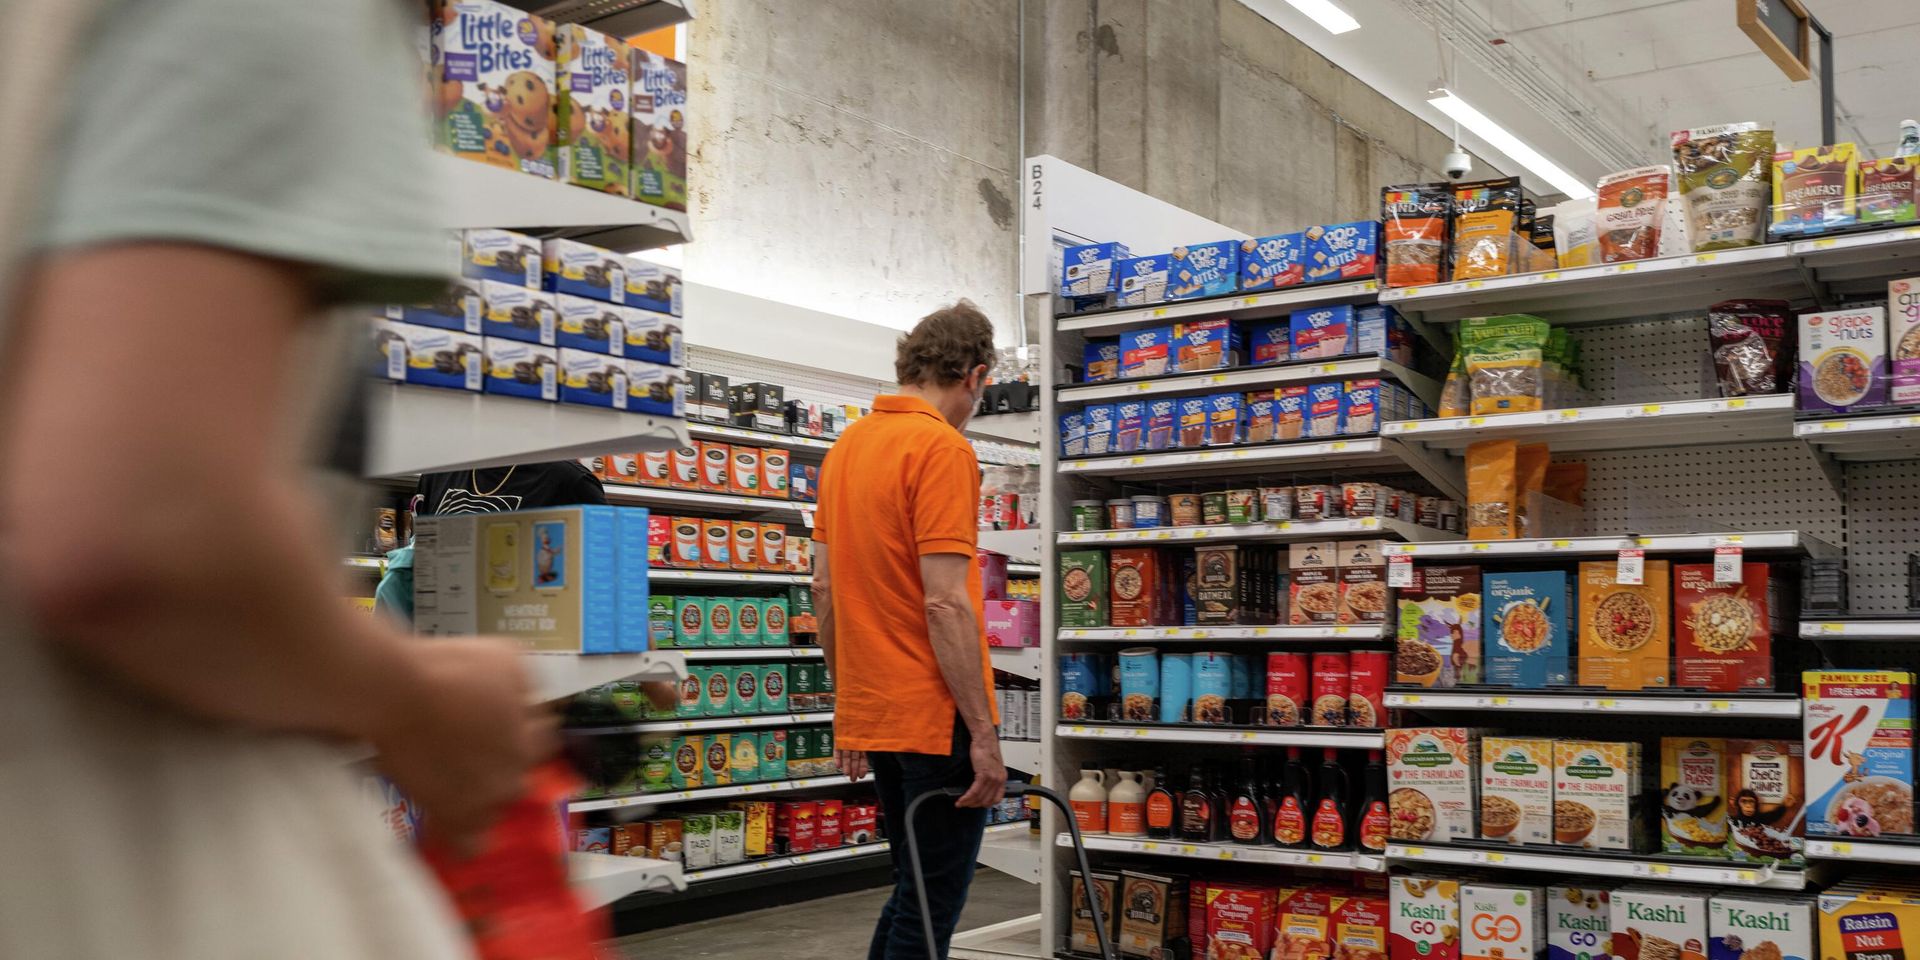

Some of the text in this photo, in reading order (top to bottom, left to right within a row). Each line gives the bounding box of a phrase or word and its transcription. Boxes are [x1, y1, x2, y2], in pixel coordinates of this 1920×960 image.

[461, 13, 513, 49] Little
[477, 43, 533, 73] Bites
[581, 46, 615, 71] Little
[592, 67, 627, 86] Bites
[644, 68, 677, 92] Little
[654, 89, 686, 106] Bites
[1032, 164, 1042, 210] B24
[1785, 185, 1842, 199] BREAKFAST
[1328, 248, 1358, 267] BITES
[1261, 259, 1290, 278] BITES
[1828, 314, 1874, 334] grape
[1587, 576, 1617, 589] orga
[1198, 591, 1233, 601] OATMEAL
[1491, 587, 1535, 599] organic
[504, 604, 549, 617] MEMORIES
[509, 618, 537, 631] EVERY
[539, 618, 557, 631] BOX
[988, 619, 1013, 630] poppi
[1820, 673, 1888, 683] FAMILY SIZE
[1832, 687, 1854, 697] FREE
[1855, 687, 1877, 697] BOOK
[1809, 704, 1870, 766] K
[1867, 749, 1905, 760] Original
[1404, 770, 1465, 779] THE FARMLAND
[1495, 778, 1549, 789] THE FARMLAND
[1567, 782, 1624, 793] THE FARMLAND
[1400, 902, 1446, 921] Kashi
[1473, 902, 1498, 913] Kashi
[1627, 901, 1687, 924] Kashi
[1410, 920, 1436, 935] GO
[1558, 912, 1608, 932] Kashi
[1728, 908, 1791, 931] Kashi
[1842, 915, 1894, 931] Raisin
[1471, 913, 1522, 943] GO
[1569, 931, 1597, 947] GO
[1854, 934, 1886, 947] Nut
